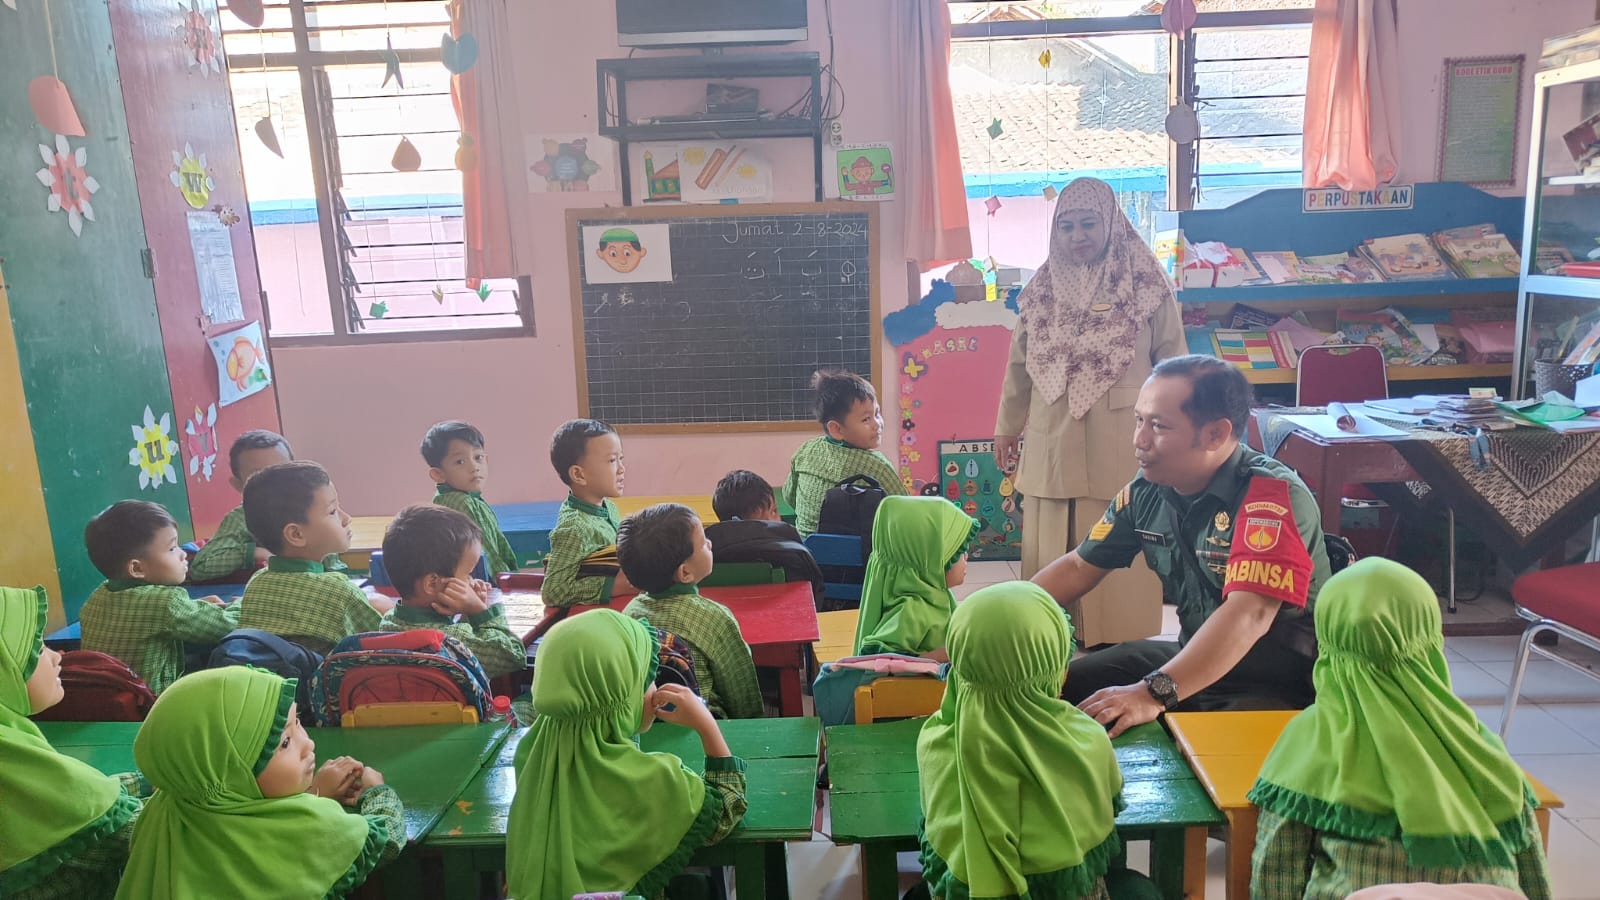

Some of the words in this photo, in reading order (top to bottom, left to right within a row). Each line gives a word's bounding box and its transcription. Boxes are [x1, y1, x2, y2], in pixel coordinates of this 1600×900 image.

[61, 167, 79, 199] t
[182, 172, 203, 193] w
[1308, 190, 1408, 207] PERPUSTAKAAN
[722, 221, 784, 244] Jumat
[144, 439, 165, 464] u
[1225, 560, 1294, 593] BABINSA
